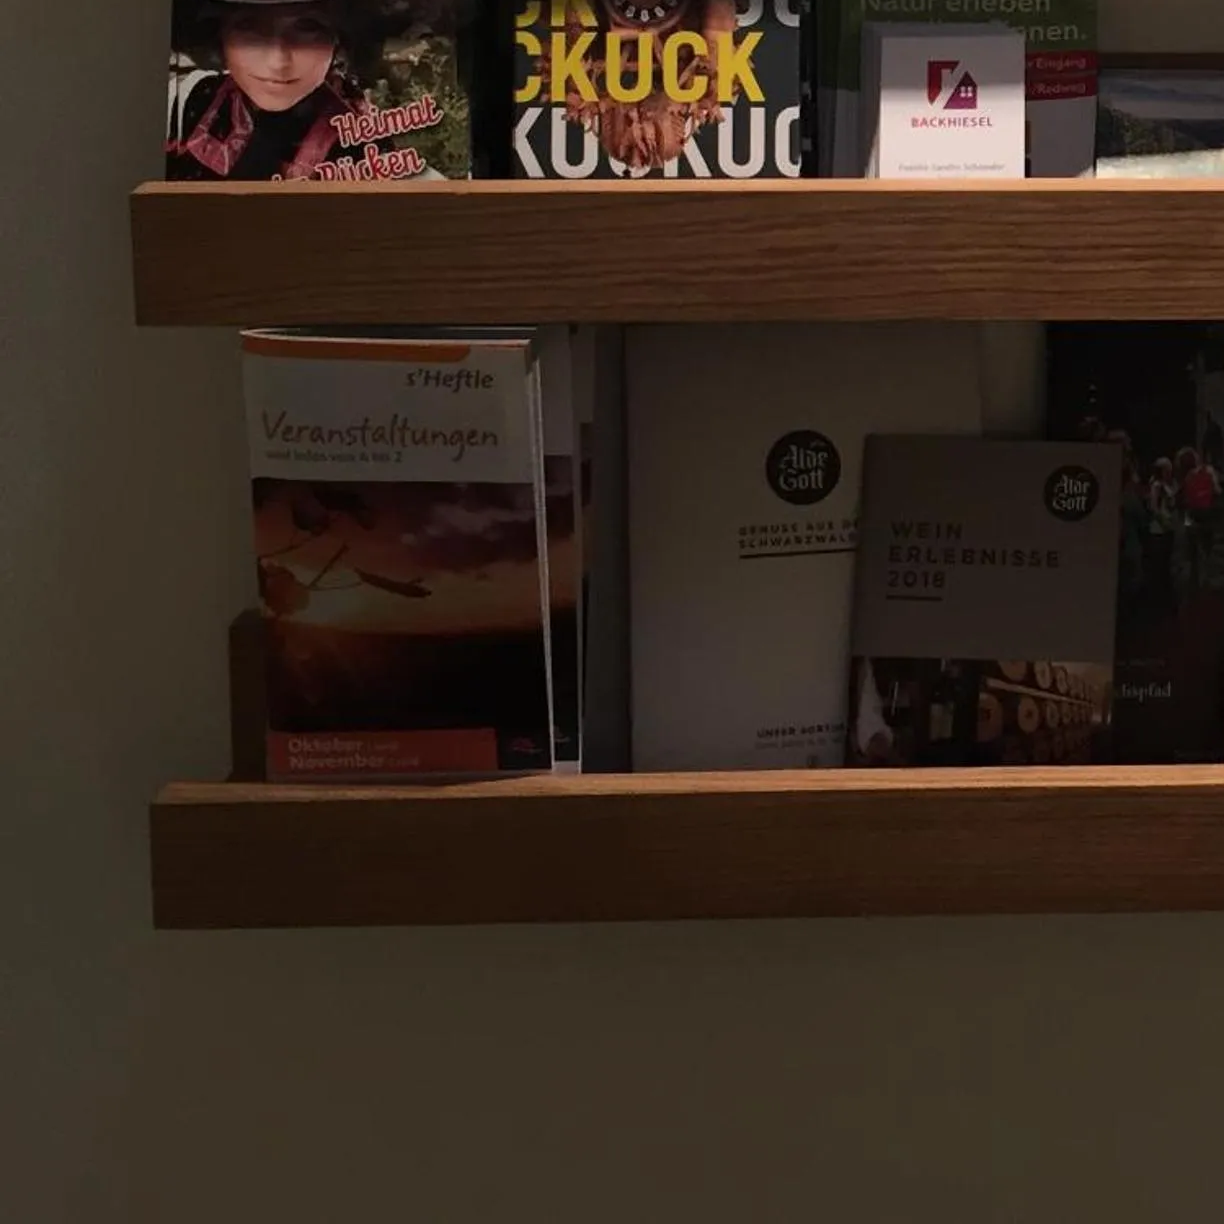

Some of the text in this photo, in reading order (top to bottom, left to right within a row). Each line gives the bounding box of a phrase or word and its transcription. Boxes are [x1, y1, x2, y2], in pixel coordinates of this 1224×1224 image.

[329, 95, 446, 147] Heimat
[910, 116, 993, 128] BACKHIESEL
[405, 368, 495, 393] s'Heftle
[262, 409, 499, 463] Veranstaltungen
[889, 521, 964, 541] WEIN
[738, 533, 850, 550] SCHWARZWAL
[887, 544, 1060, 569] ERLEBNISSE
[887, 570, 947, 589] 2018
[288, 736, 364, 753] Oktober
[288, 754, 385, 770] November
